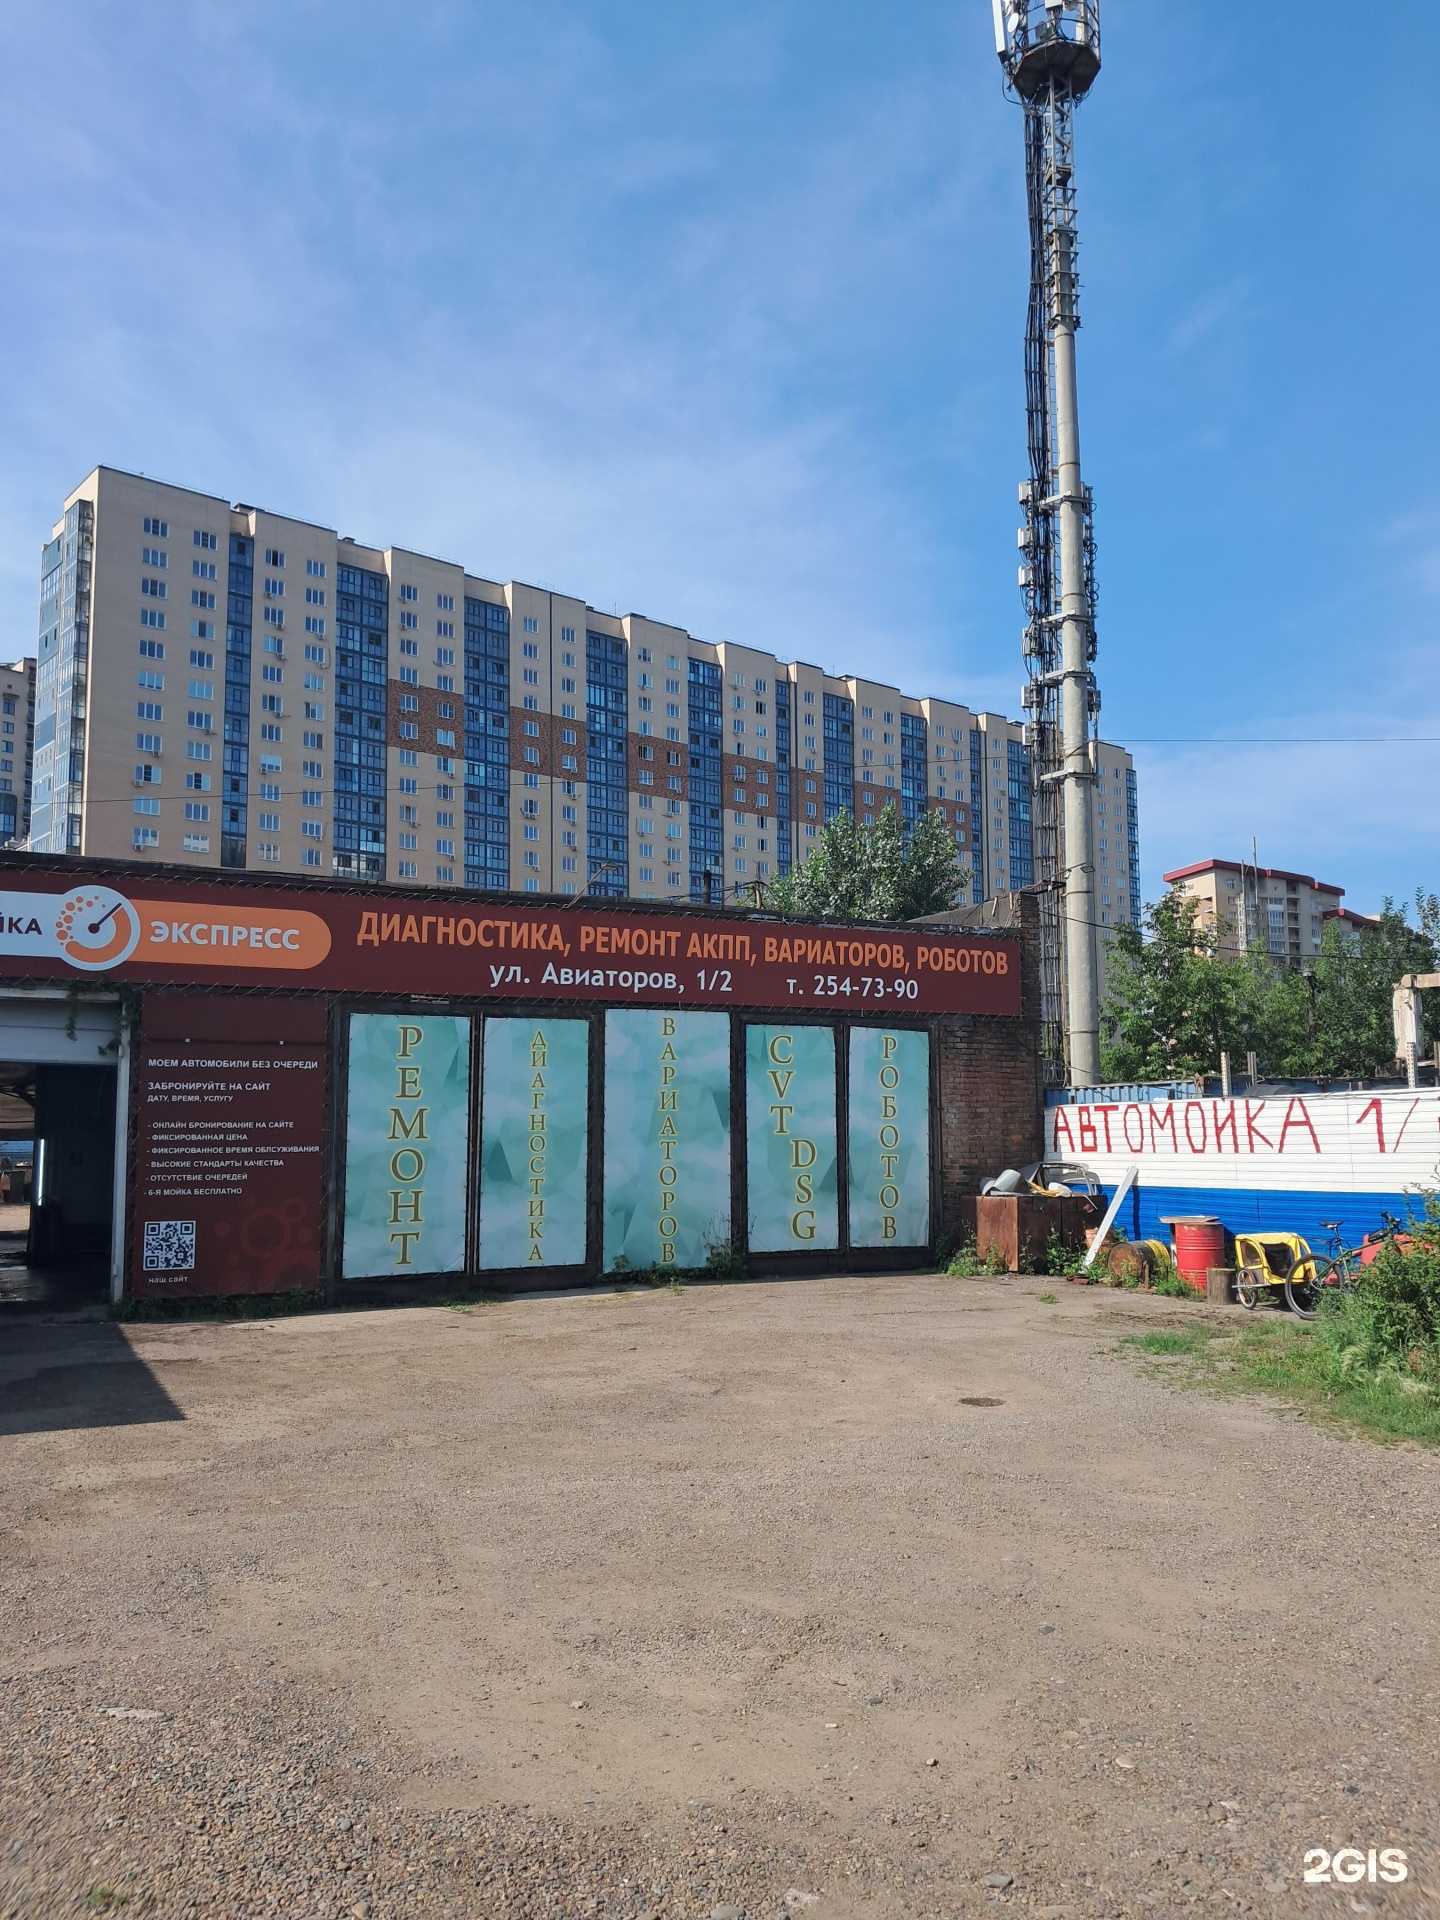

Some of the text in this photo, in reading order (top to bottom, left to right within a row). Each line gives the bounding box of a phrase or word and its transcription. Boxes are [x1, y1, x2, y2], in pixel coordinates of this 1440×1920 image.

[150, 920, 300, 950] ЭКСПРЕСС
[356, 911, 1009, 975] ДИАГНОСТИКА, РЕМОНТ АКПП, ВАРИАТОРОВ, РОБОТОВ
[489, 962, 919, 1000] ул. Авиаторов, 1/2 т. 254-73-90
[148, 1059, 319, 1070] МОЕМ АВТОМОБИЛИ БЕЗ ОЧЕРЕДИ
[147, 1081, 271, 1091] ЗАБРОНИРУЙТЕ НА САЙТ
[147, 1095, 234, 1103] ДАТУ, ВРЕМЯ, УСЛУГУ
[768, 1035, 794, 1134] CVT
[152, 1121, 187, 1129] ОНЛАЙН
[268, 1121, 295, 1129] САЙТЕ
[658, 1016, 678, 1264] ВАРИАТОРОВ
[879, 1036, 899, 1240] РОБОТОВ
[1356, 1097, 1440, 1153] 1/
[151, 1147, 224, 1155] ФИКСИРОВАННОЕ
[387, 1025, 429, 1265] РЕМОНТ
[527, 1030, 547, 1262] ДИАГНОСТИКА
[150, 1159, 284, 1169] ВЫСОКИЕ СТАНДАРТЫ КАЧЕСТВА
[150, 1174, 203, 1182] ОТСУТСТВИЕ
[163, 1188, 192, 1196] МОЙКА
[194, 1188, 242, 1196] БЕСПЛАТНО
[790, 1139, 817, 1240] DSG
